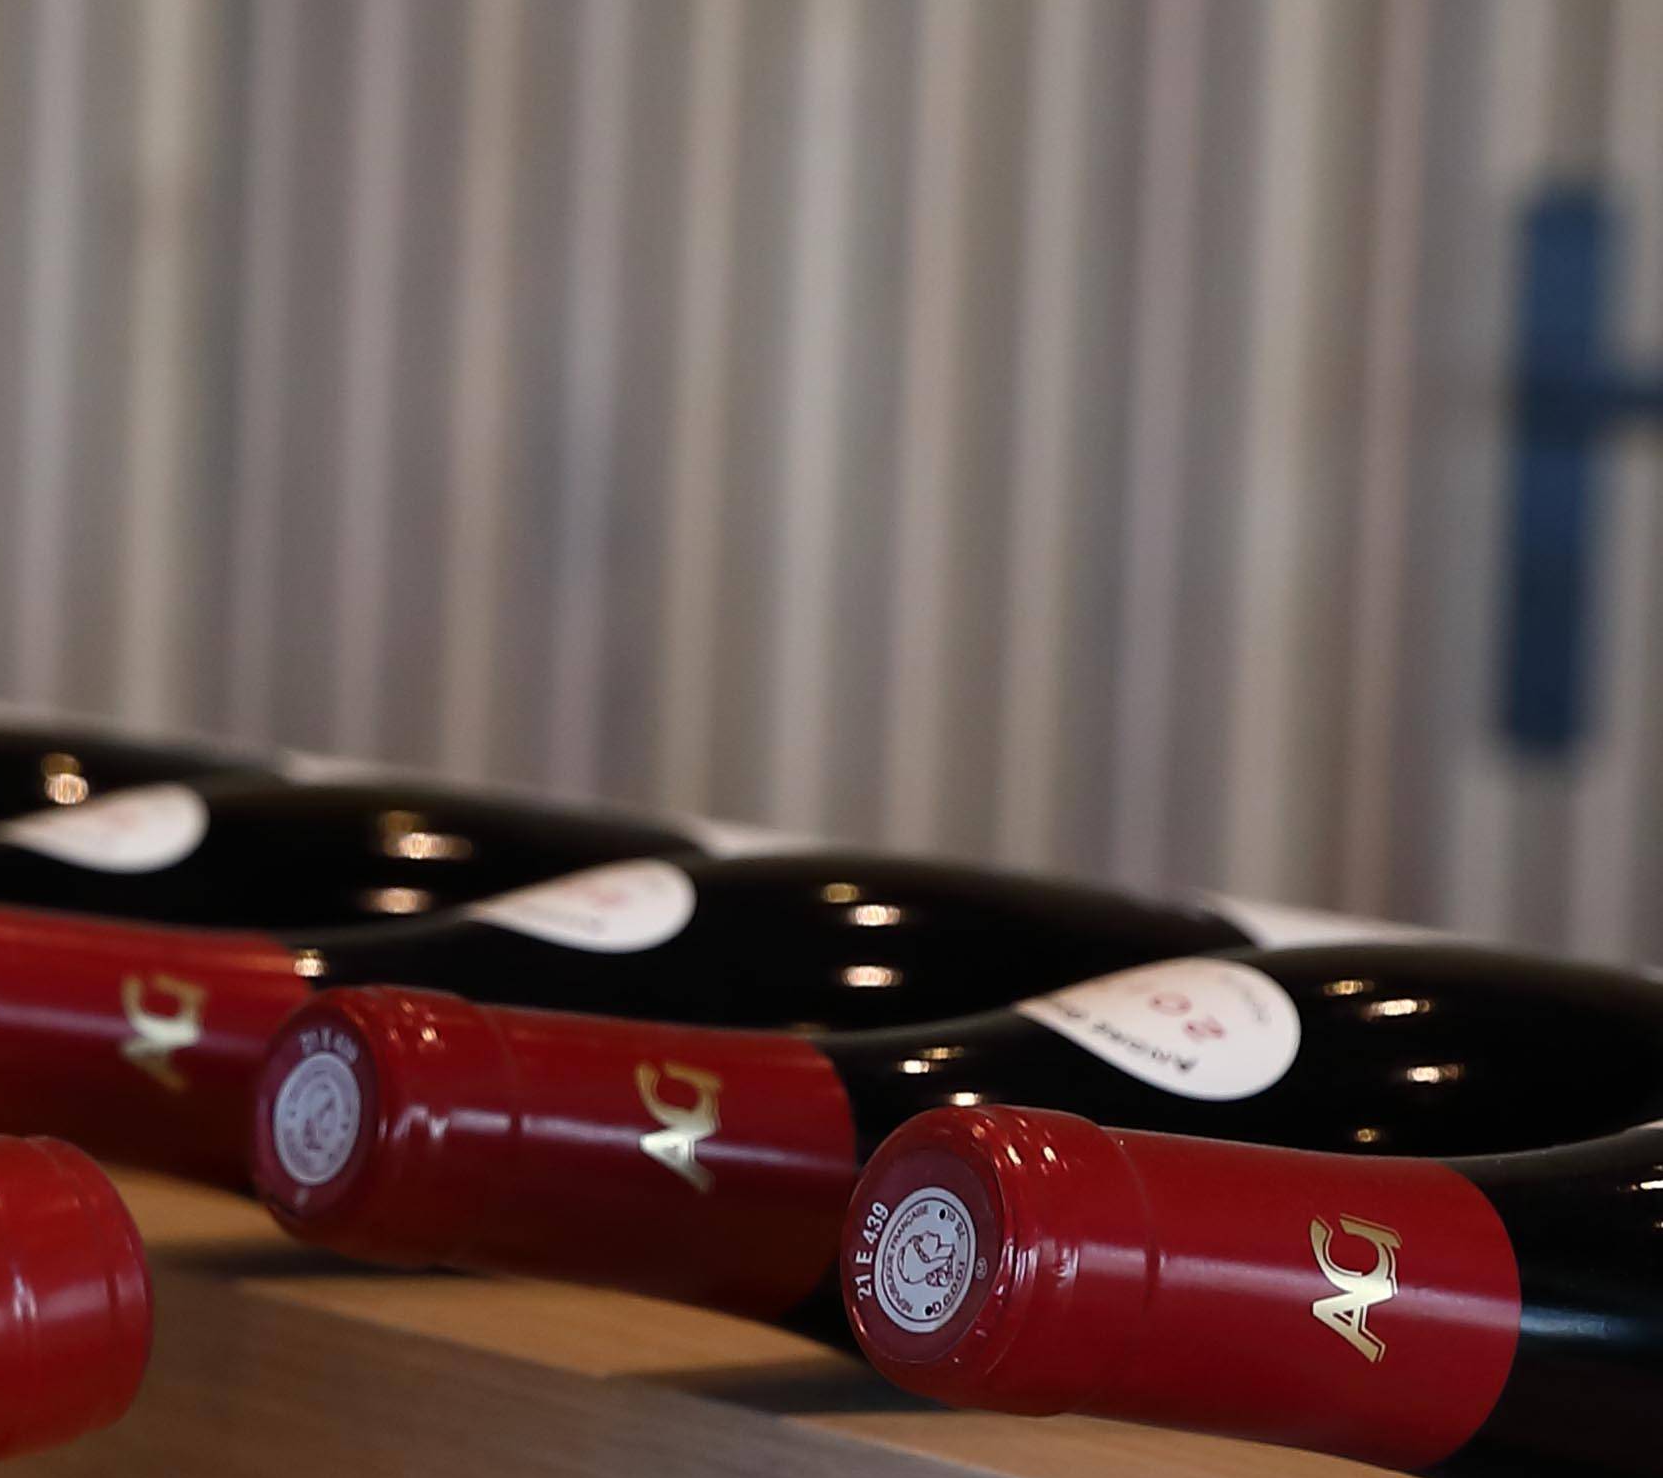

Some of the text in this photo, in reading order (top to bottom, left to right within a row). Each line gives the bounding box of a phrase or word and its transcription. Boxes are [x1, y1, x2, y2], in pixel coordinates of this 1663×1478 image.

[854, 1201, 889, 1302] 21 E 439
